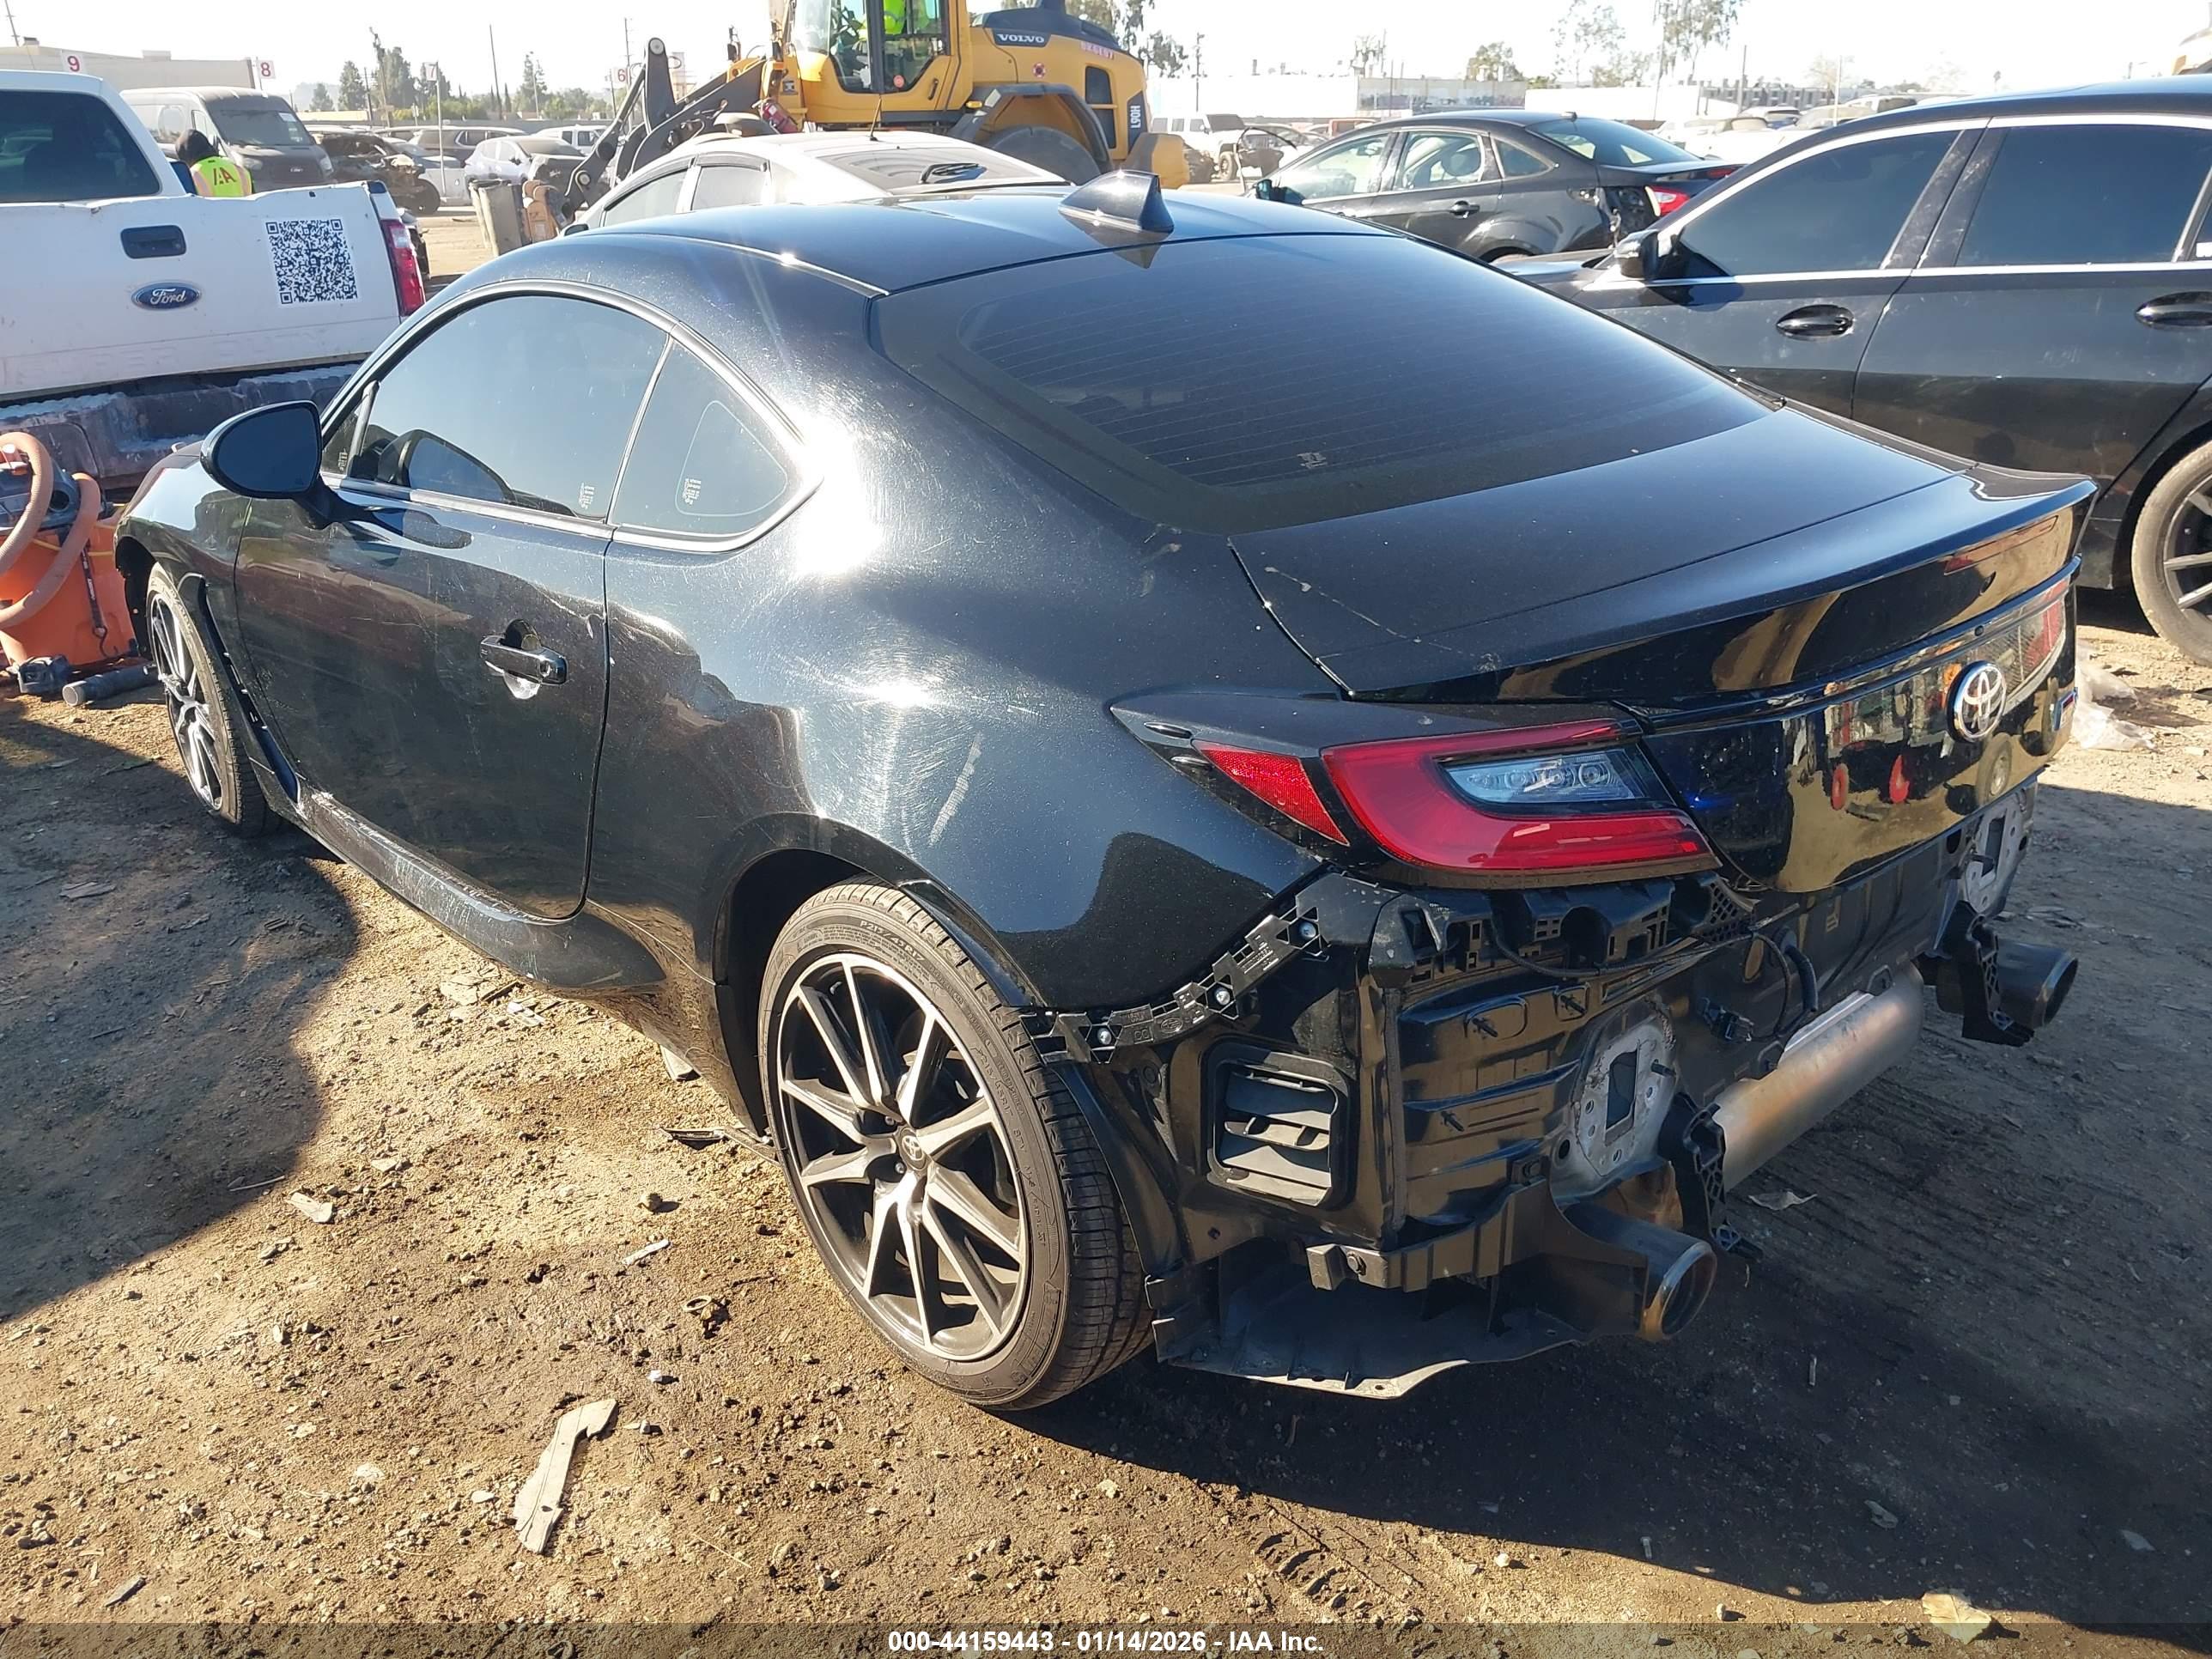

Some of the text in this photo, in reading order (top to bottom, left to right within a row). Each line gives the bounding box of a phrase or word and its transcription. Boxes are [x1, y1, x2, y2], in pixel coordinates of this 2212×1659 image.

[996, 33, 1045, 43] VOLVO
[67, 55, 81, 72] 9
[261, 62, 271, 77] 8
[428, 64, 436, 78] 7
[617, 69, 626, 82] 6
[1130, 105, 1141, 129] L90H
[149, 288, 186, 305] Ford
[860, 920, 926, 961] P215/45R17
